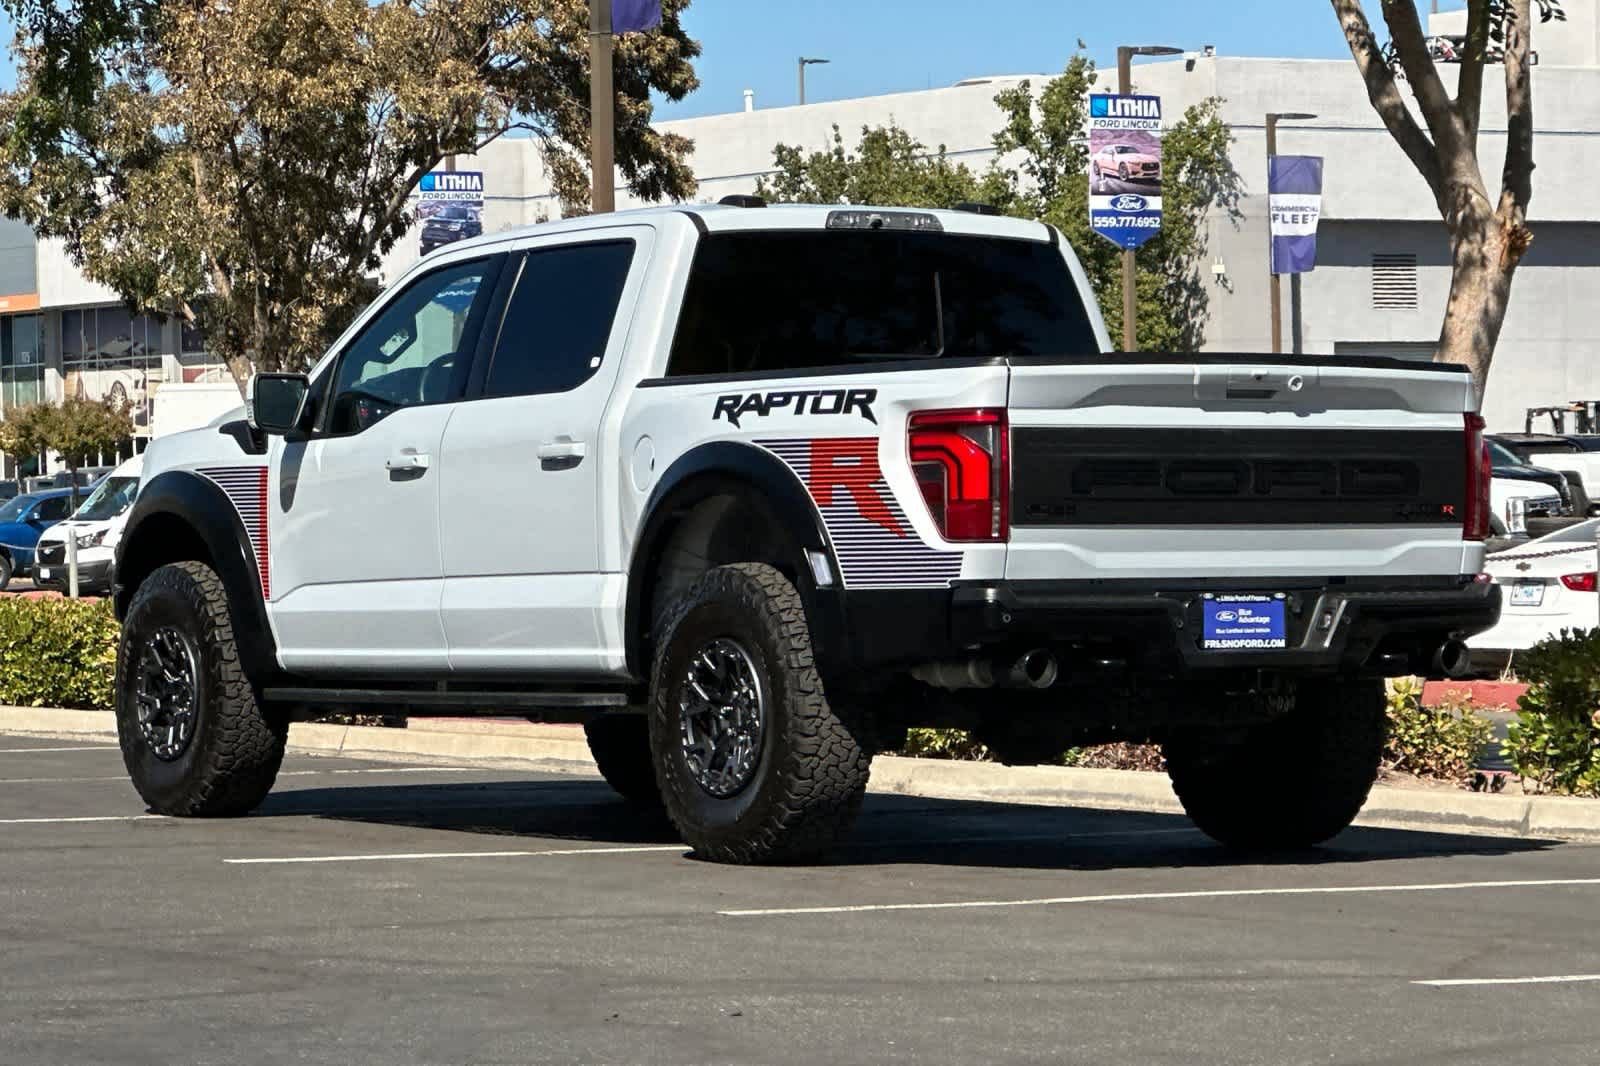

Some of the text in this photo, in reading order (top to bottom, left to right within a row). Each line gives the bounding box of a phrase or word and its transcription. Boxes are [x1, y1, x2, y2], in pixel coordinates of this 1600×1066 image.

[1107, 98, 1160, 117] LITHIA
[1093, 119, 1159, 129] FORD LINCOLN
[434, 174, 482, 190] LITHIA
[422, 192, 481, 200] FORD LINCOLN
[1093, 215, 1161, 228] 559.777.6952
[1271, 213, 1317, 224] FLEET
[711, 388, 878, 429] RAPTOR
[1069, 457, 1421, 496] FORD
